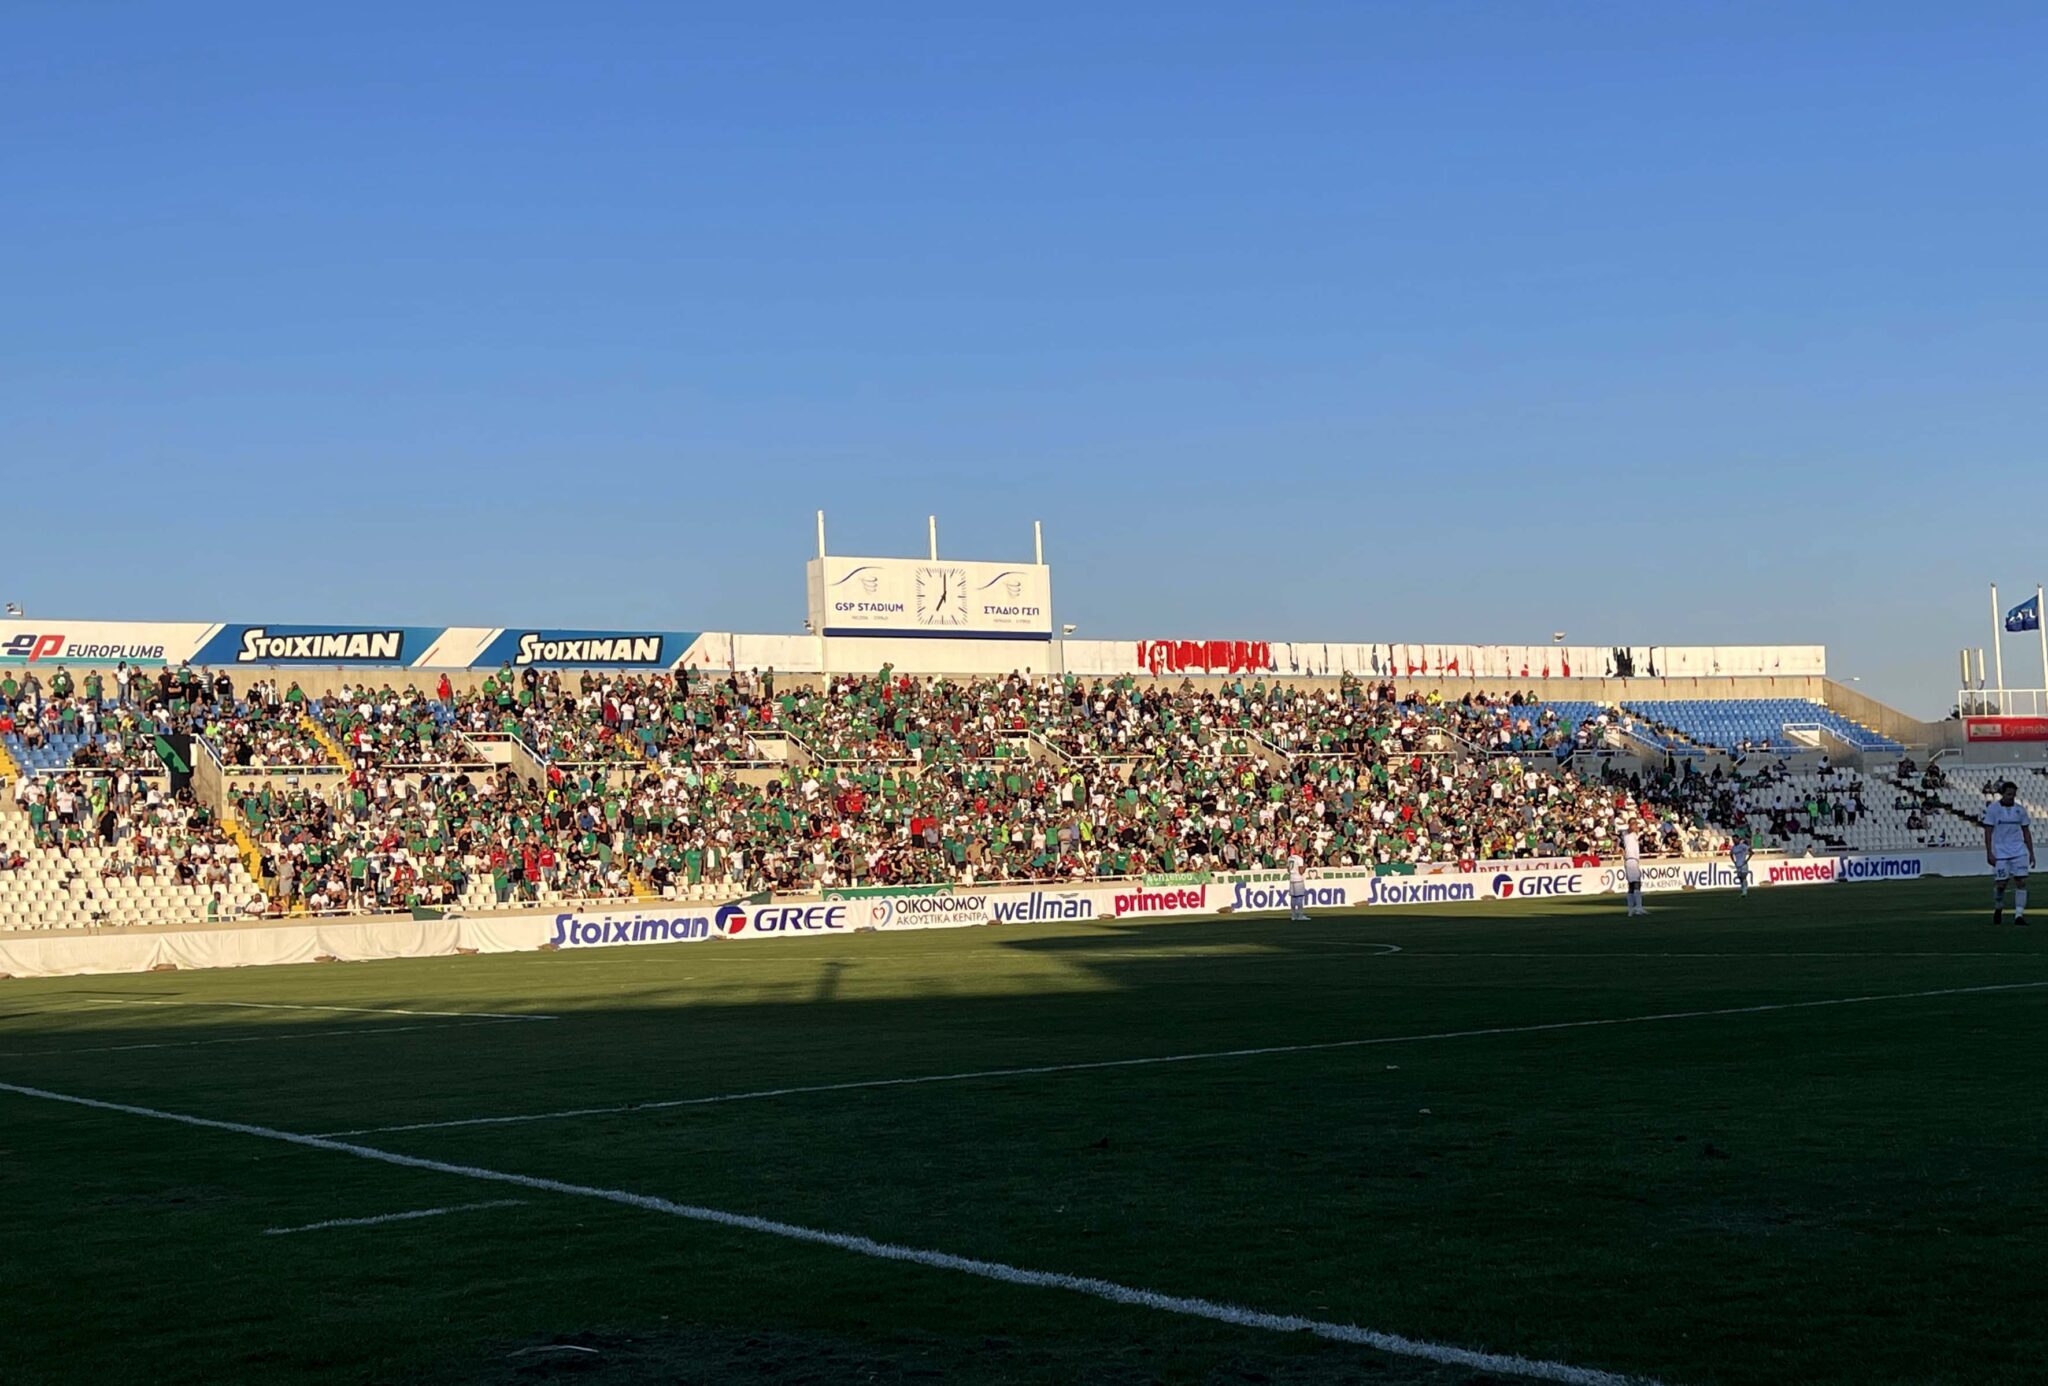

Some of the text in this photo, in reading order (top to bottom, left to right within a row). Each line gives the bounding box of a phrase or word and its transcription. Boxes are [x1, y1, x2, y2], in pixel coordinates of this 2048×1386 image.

[835, 602, 904, 613] GSP STADIUM
[984, 605, 1040, 616] ΣΤΑΔΙΟ ΓΣΠ
[66, 644, 164, 659] EUROPLUMB
[1616, 865, 1681, 882] ΟΝΟΜΟΥ
[1768, 859, 1834, 884] primetel
[1839, 857, 1920, 878] Stoiximan
[1231, 881, 1346, 911] Stoixman
[1367, 877, 1475, 904] Stoiximan
[1519, 874, 1583, 896] GREE
[895, 896, 987, 914] ΟΙΚΟΝΟΜΟΥ
[994, 891, 1092, 921] wellman
[1114, 884, 1206, 917] primetel
[550, 913, 709, 945] Stoiximan
[754, 906, 847, 932] GREE
[896, 911, 989, 926] ΑΚΟΥΣΤΙΚΑ ΚΕΝΤΡΑ
